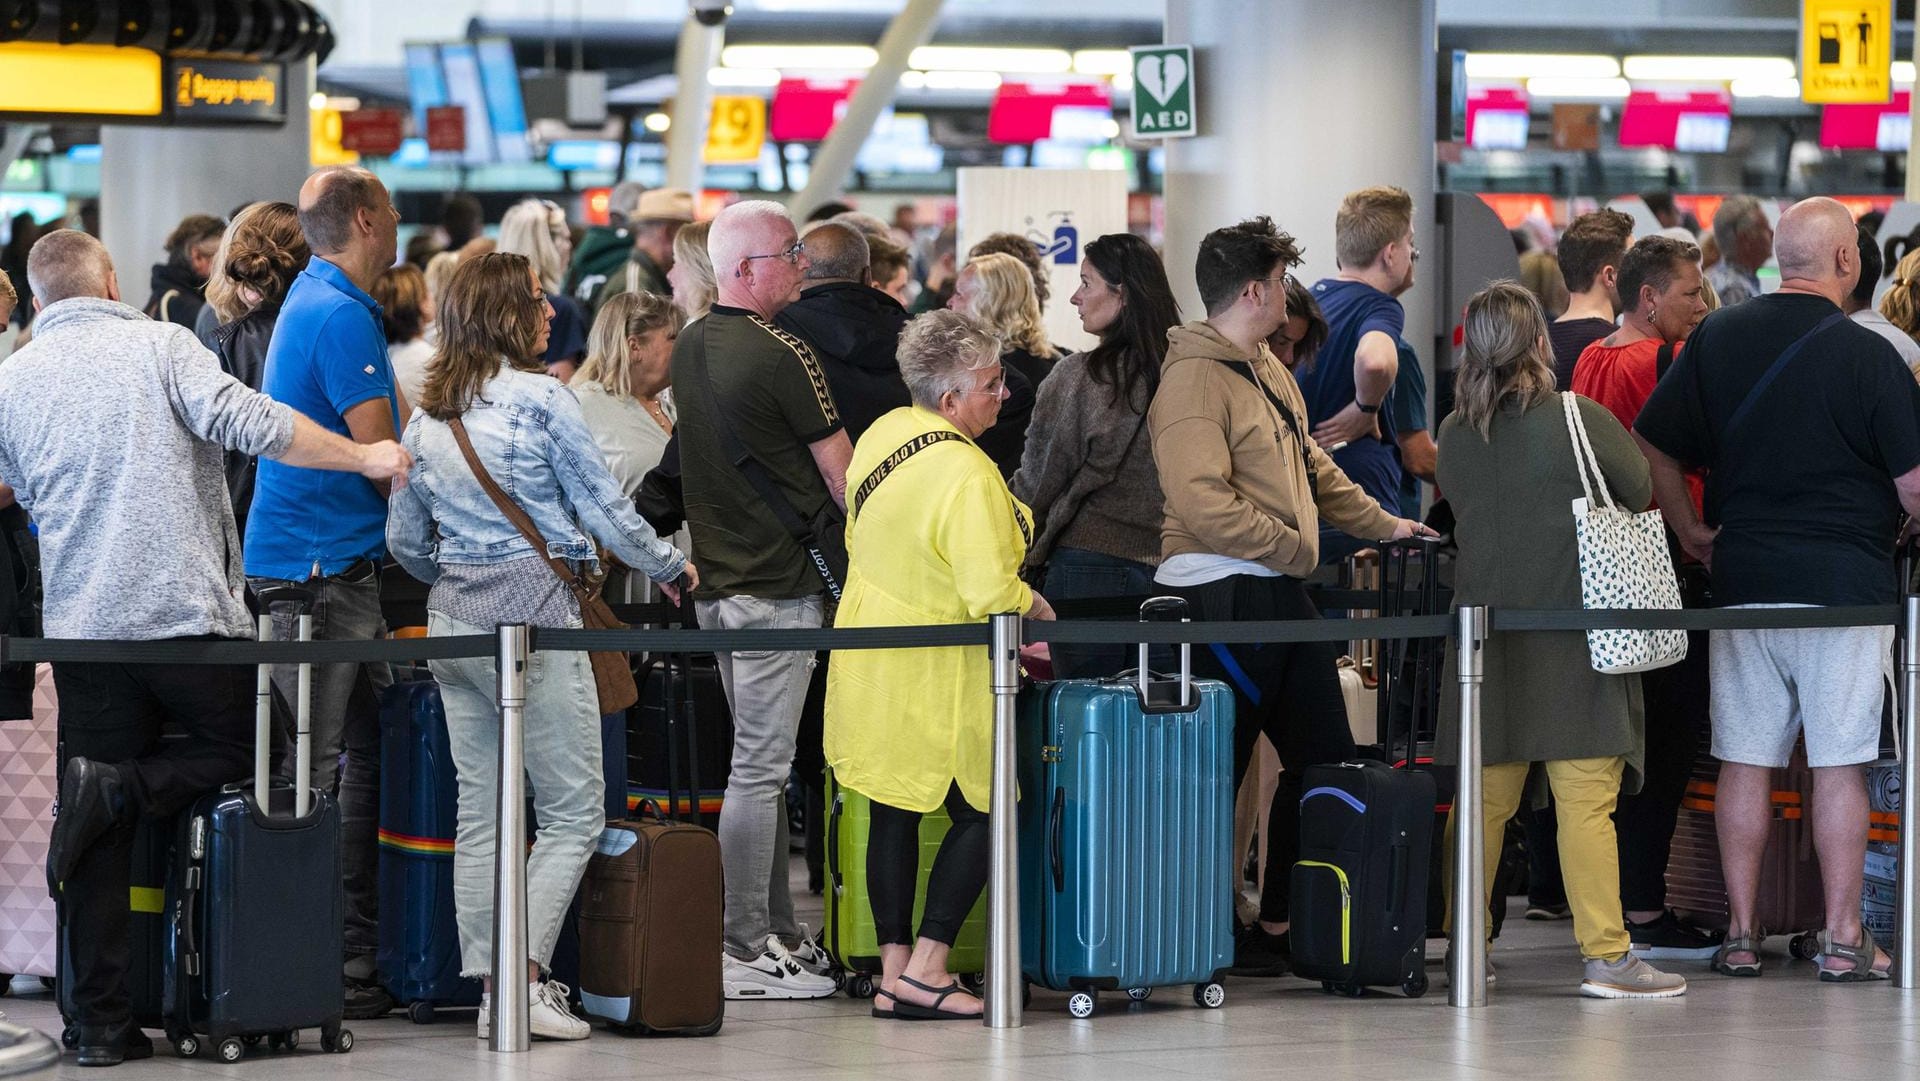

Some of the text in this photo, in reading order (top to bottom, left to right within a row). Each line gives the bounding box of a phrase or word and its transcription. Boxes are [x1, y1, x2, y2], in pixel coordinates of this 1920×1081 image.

[1140, 110, 1189, 129] AED
[866, 463, 887, 494] LOVE
[809, 548, 831, 577] SCOTT
